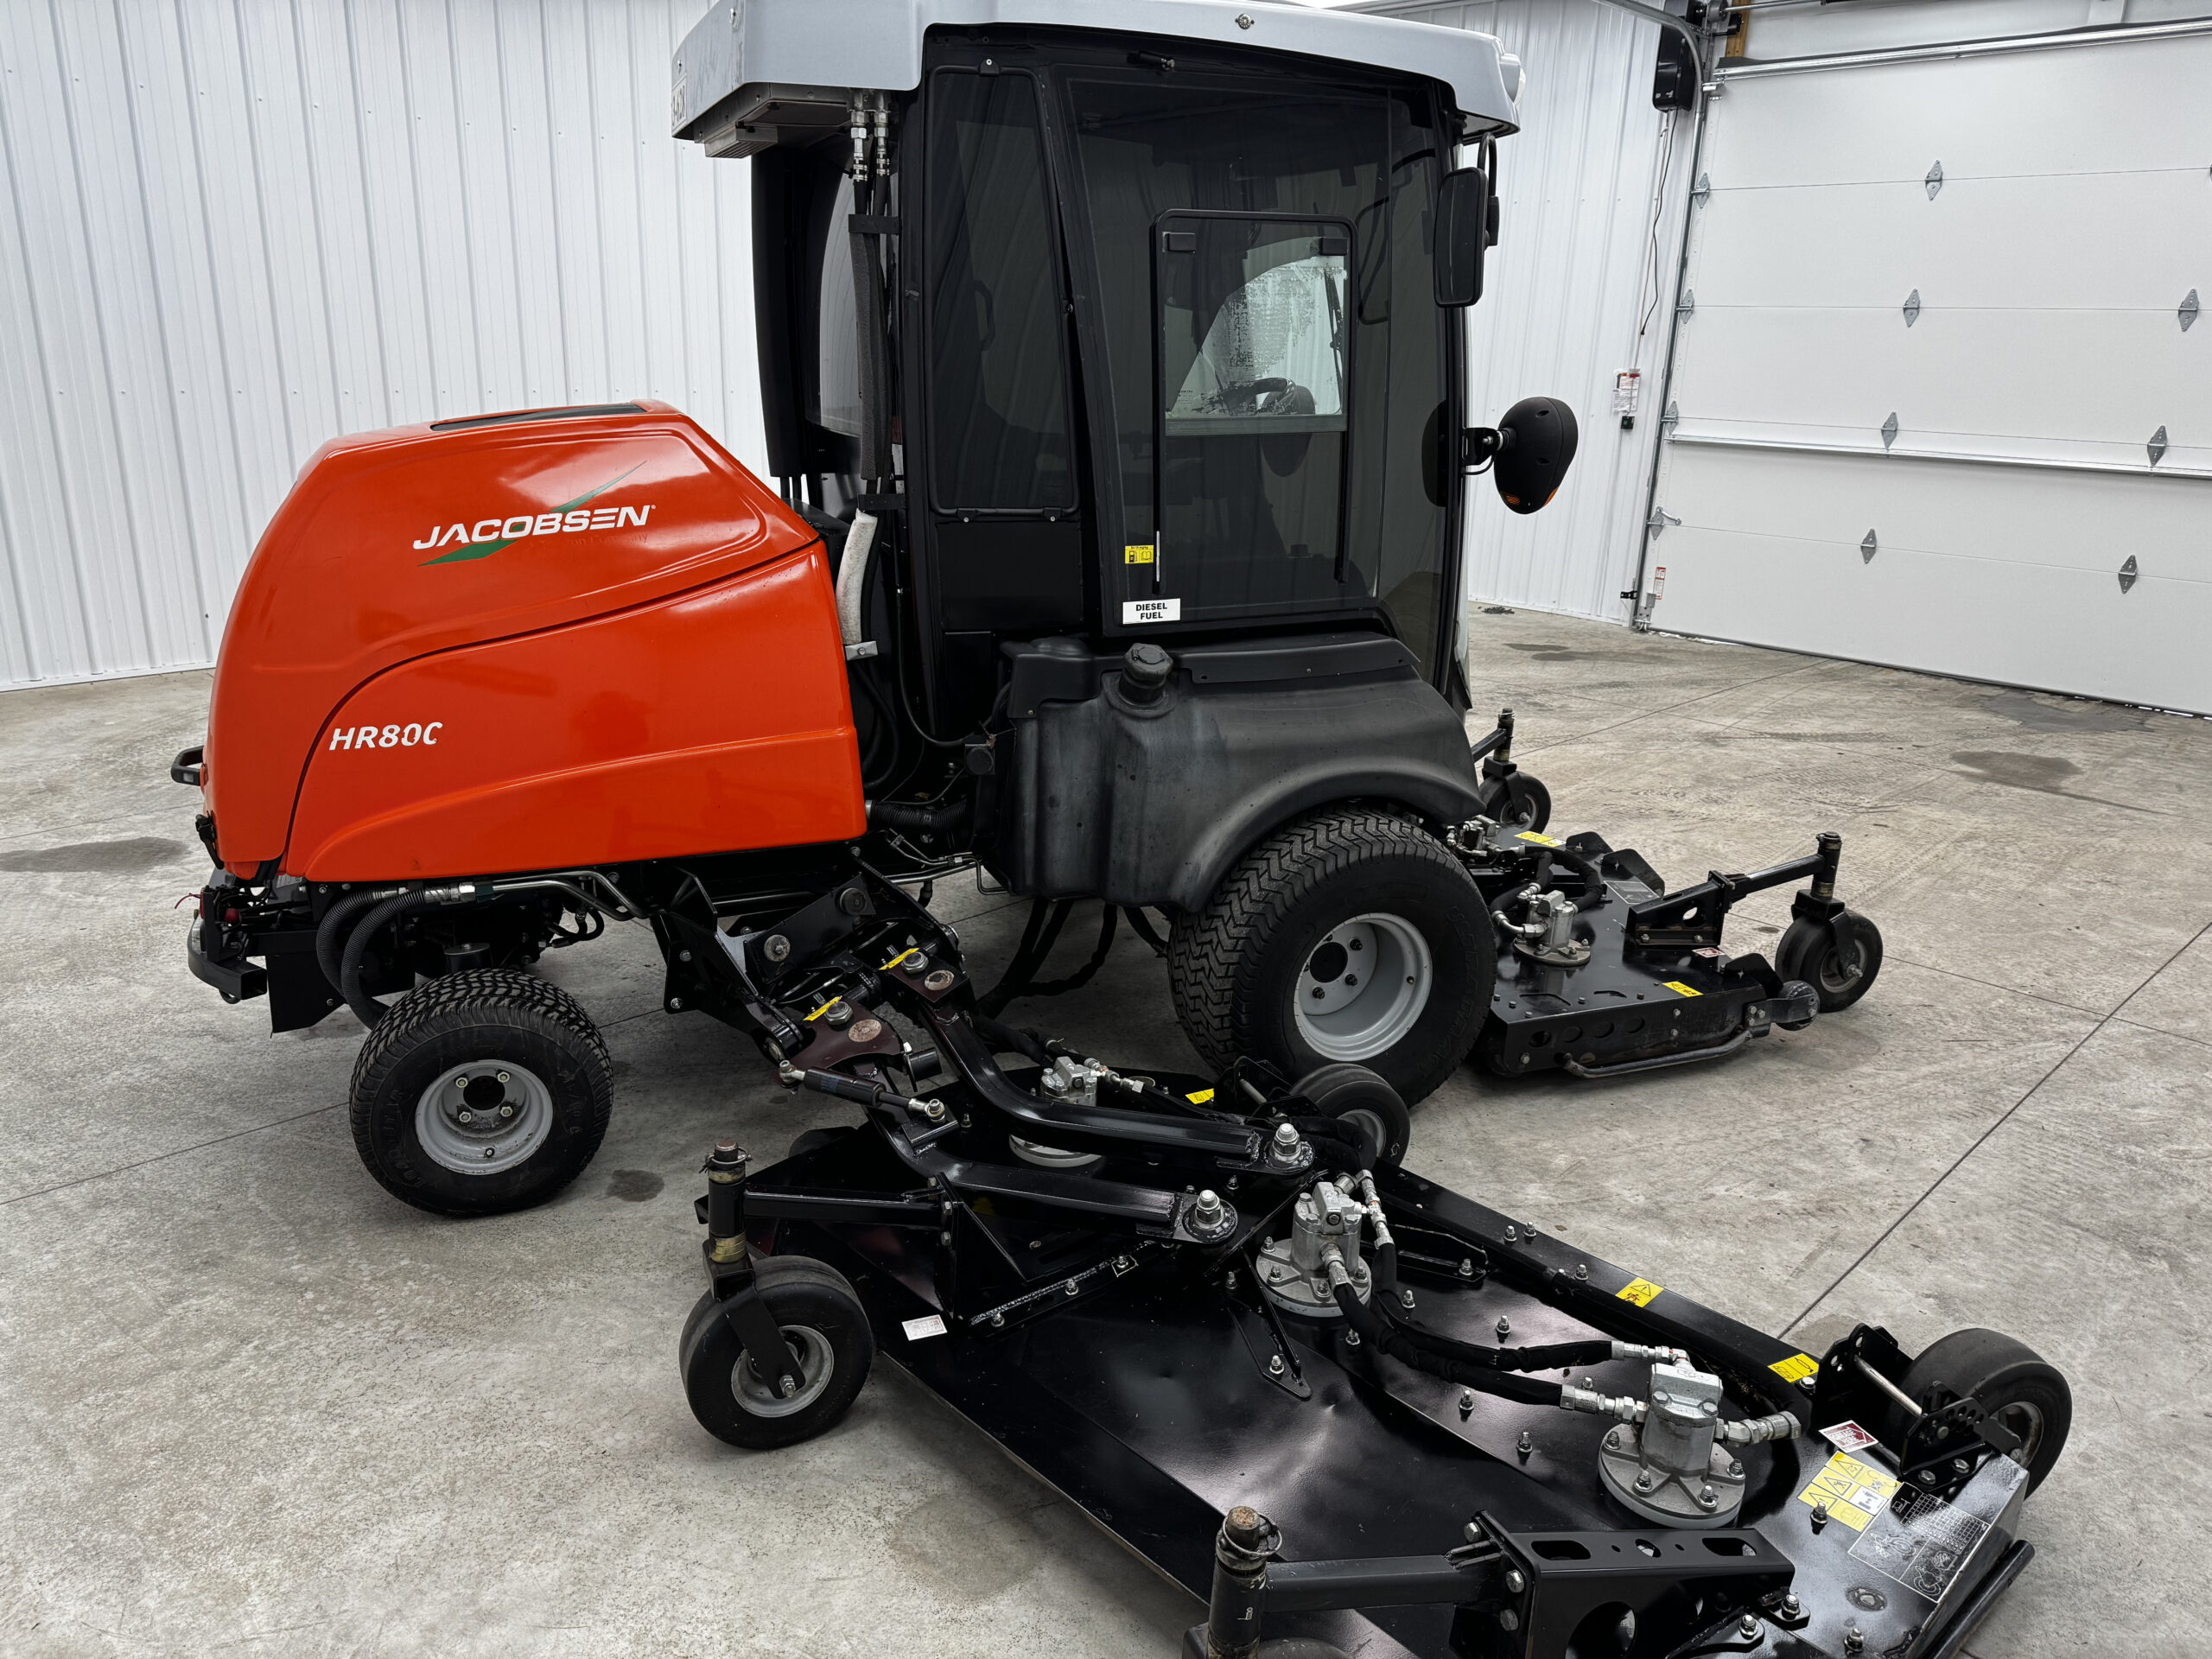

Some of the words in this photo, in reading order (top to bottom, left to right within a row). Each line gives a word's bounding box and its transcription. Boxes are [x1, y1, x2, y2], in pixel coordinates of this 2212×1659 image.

[412, 505, 651, 550] JACOBSEN
[1135, 602, 1167, 612] DIESEL
[328, 721, 443, 751] HR80C
